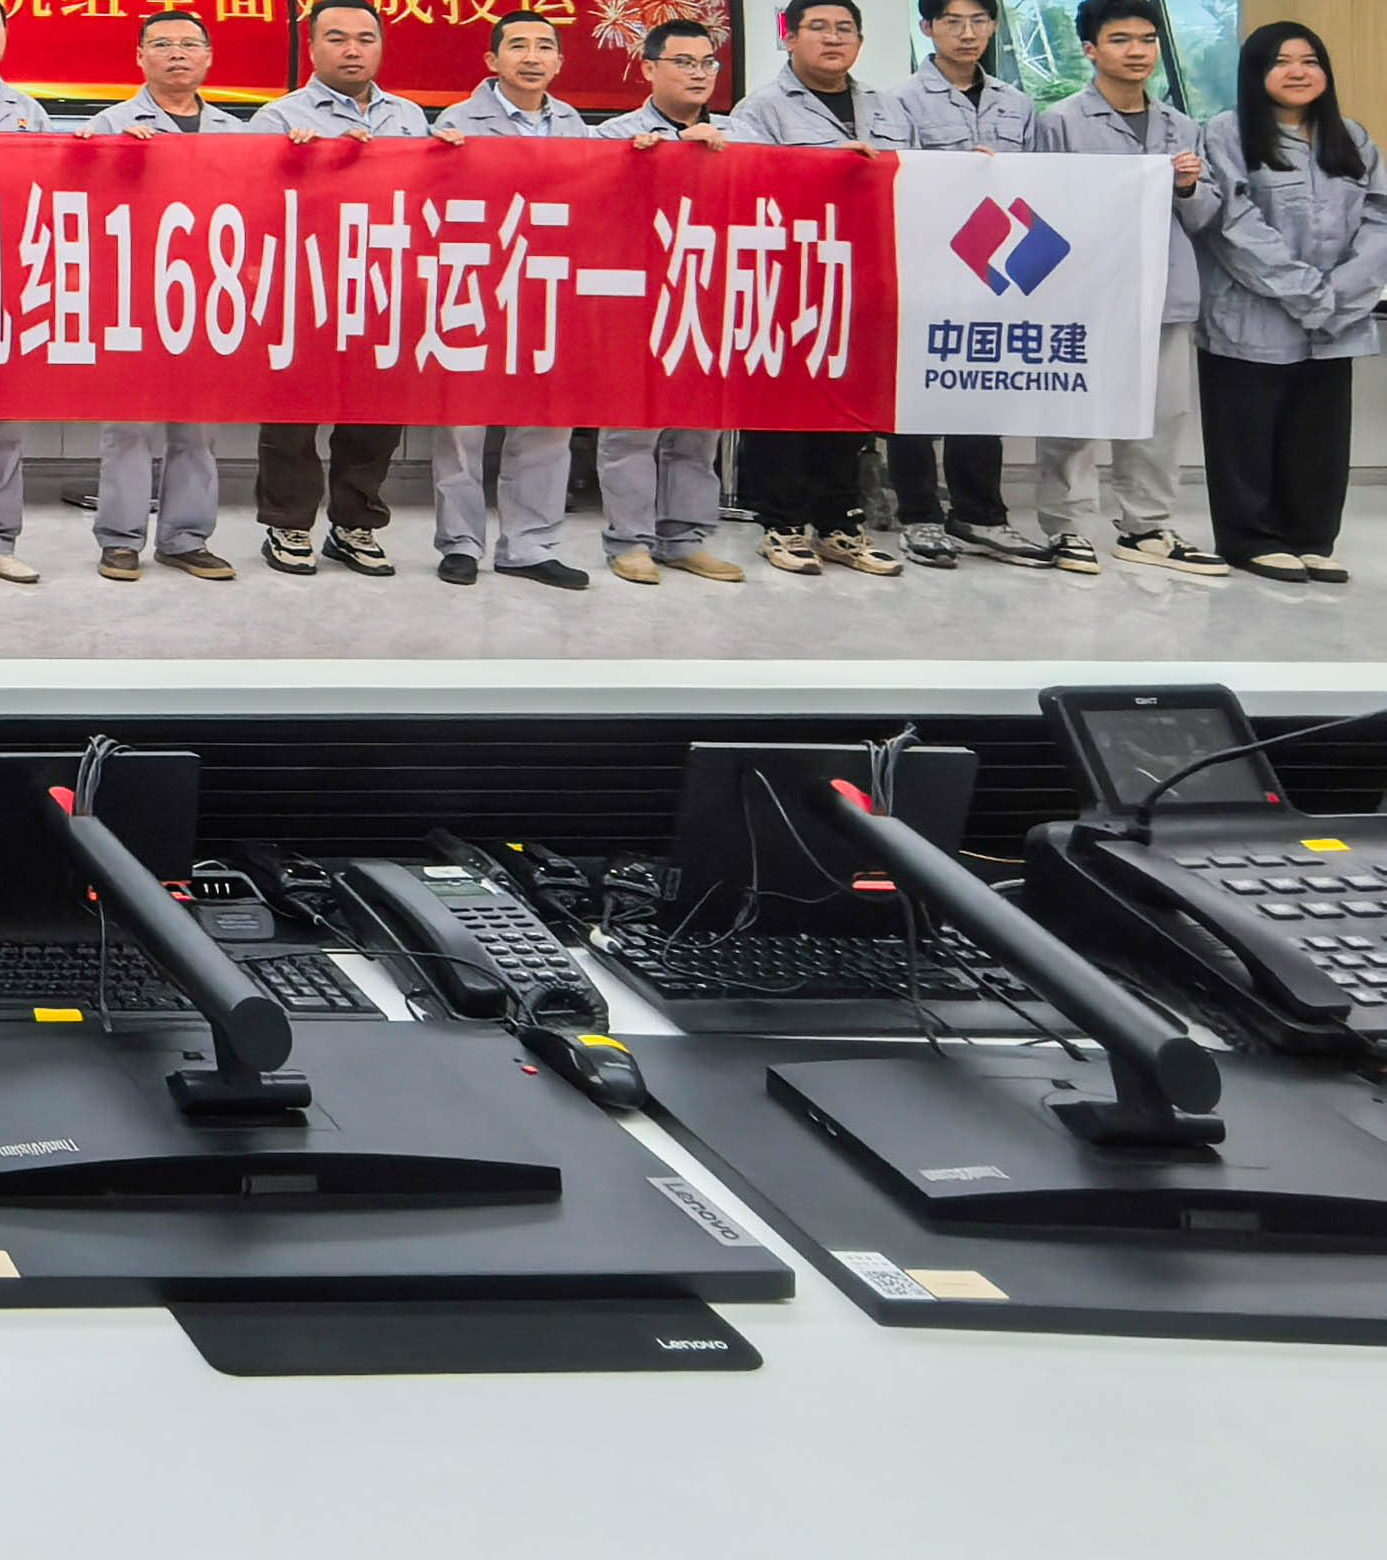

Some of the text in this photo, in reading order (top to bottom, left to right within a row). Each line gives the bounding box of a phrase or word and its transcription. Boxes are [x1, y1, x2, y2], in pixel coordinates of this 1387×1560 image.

[928, 320, 1088, 364] 中国电建
[925, 369, 1088, 392] POWERCHINA
[656, 1337, 729, 1350] Lenovo
